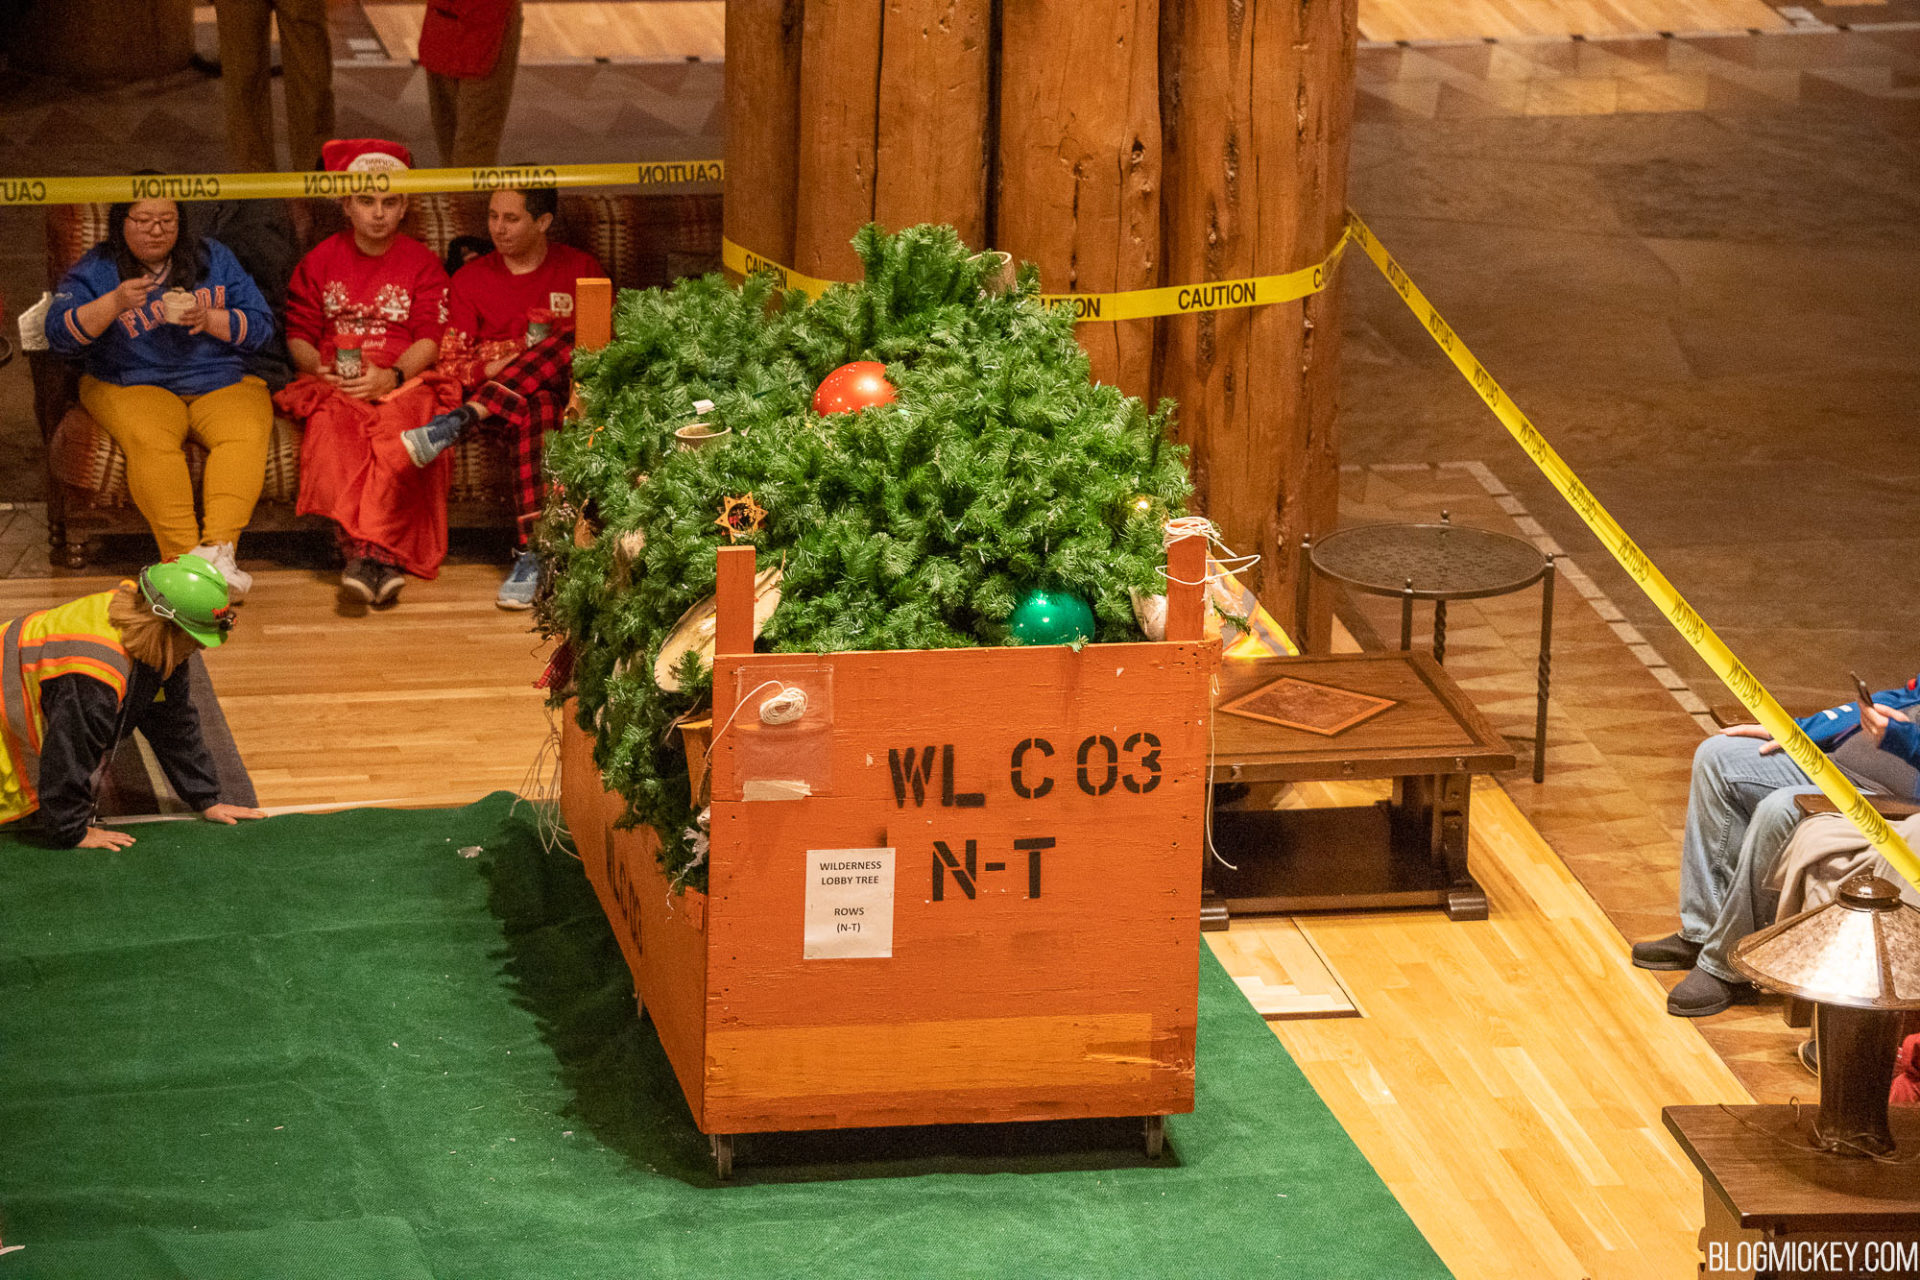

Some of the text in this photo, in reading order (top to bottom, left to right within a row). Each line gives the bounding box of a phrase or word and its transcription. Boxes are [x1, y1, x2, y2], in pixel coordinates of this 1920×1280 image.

[1178, 281, 1256, 310] CAUTION
[889, 743, 985, 808] WL
[820, 861, 882, 871] WILDERNESS
[932, 836, 1056, 901] N-T
[821, 876, 879, 886] LOBBY TREE
[834, 907, 864, 916] ROWS
[837, 922, 861, 933] (N-T)
